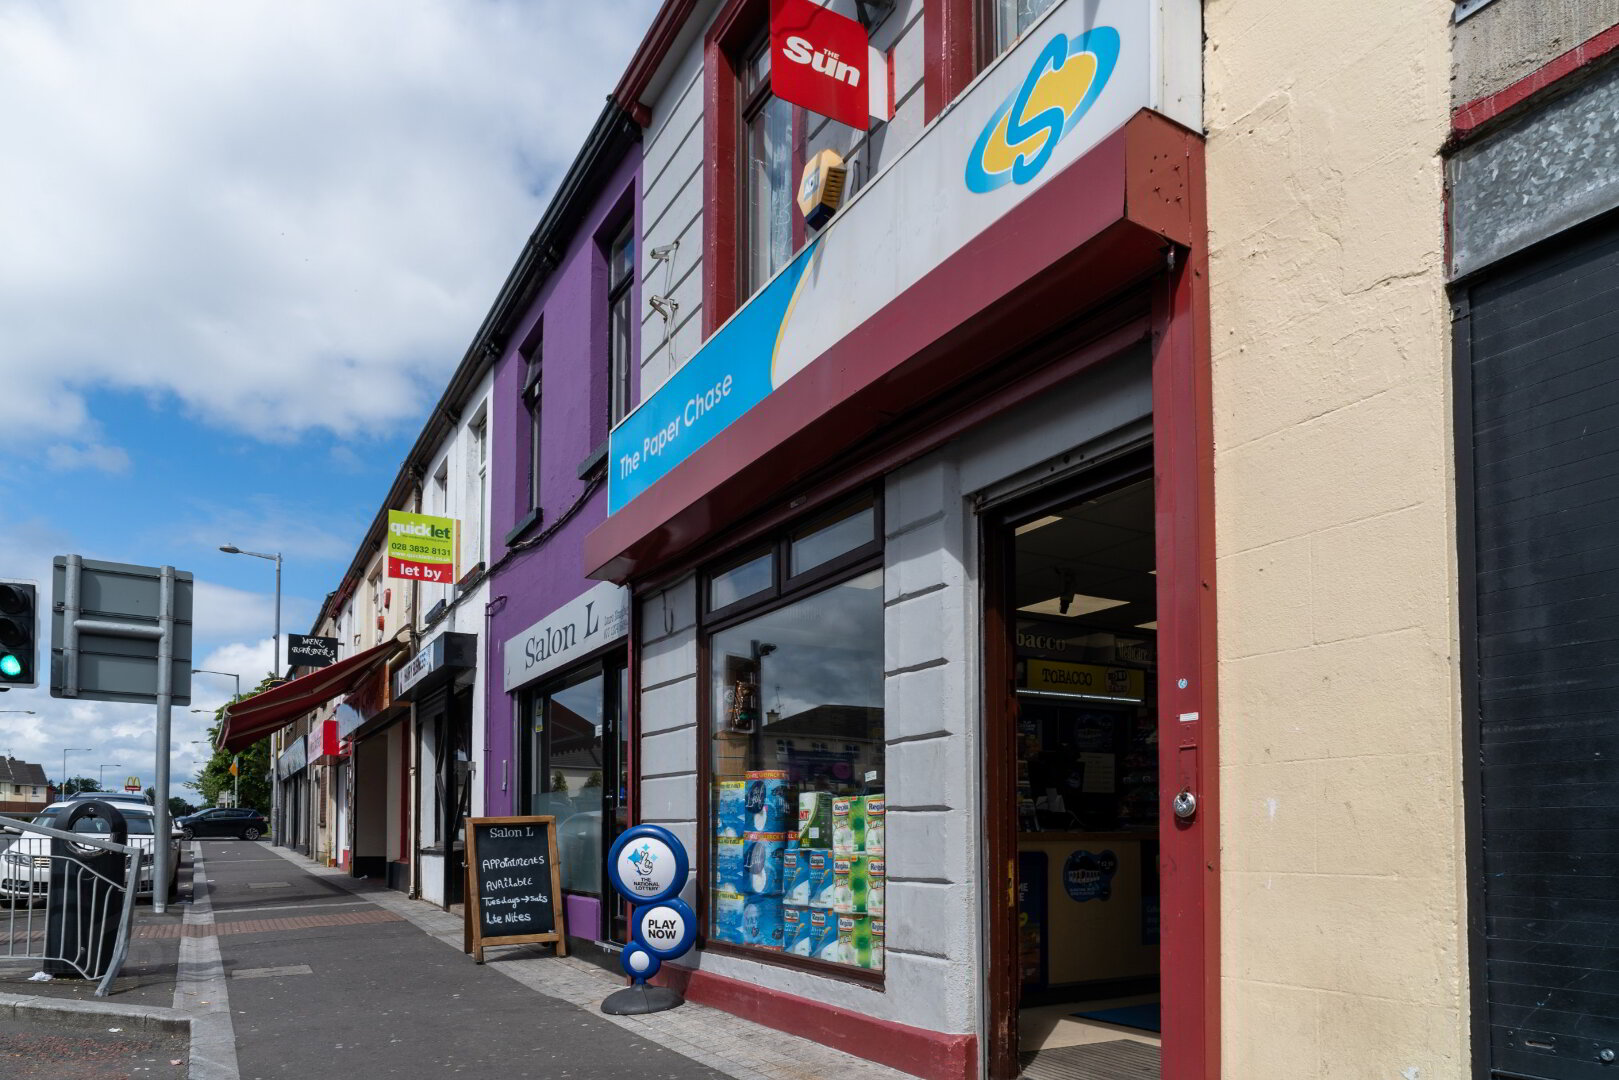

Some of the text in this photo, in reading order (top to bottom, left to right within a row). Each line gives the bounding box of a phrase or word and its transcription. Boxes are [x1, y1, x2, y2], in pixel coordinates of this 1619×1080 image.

[782, 35, 861, 88] Sun
[823, 48, 841, 60] THE
[620, 374, 733, 480] The Paper Chase
[391, 521, 451, 540] quicklet
[391, 542, 451, 556] 028 3832 8131
[400, 563, 442, 581] let by
[302, 636, 326, 648] MENZ
[525, 622, 576, 671] Salon
[584, 600, 599, 639] L
[1016, 629, 1066, 652] bacco
[1042, 668, 1093, 686] TOBACCO
[489, 826, 534, 838] Salon L
[647, 919, 677, 930] PLAY
[647, 929, 677, 940] NOW
